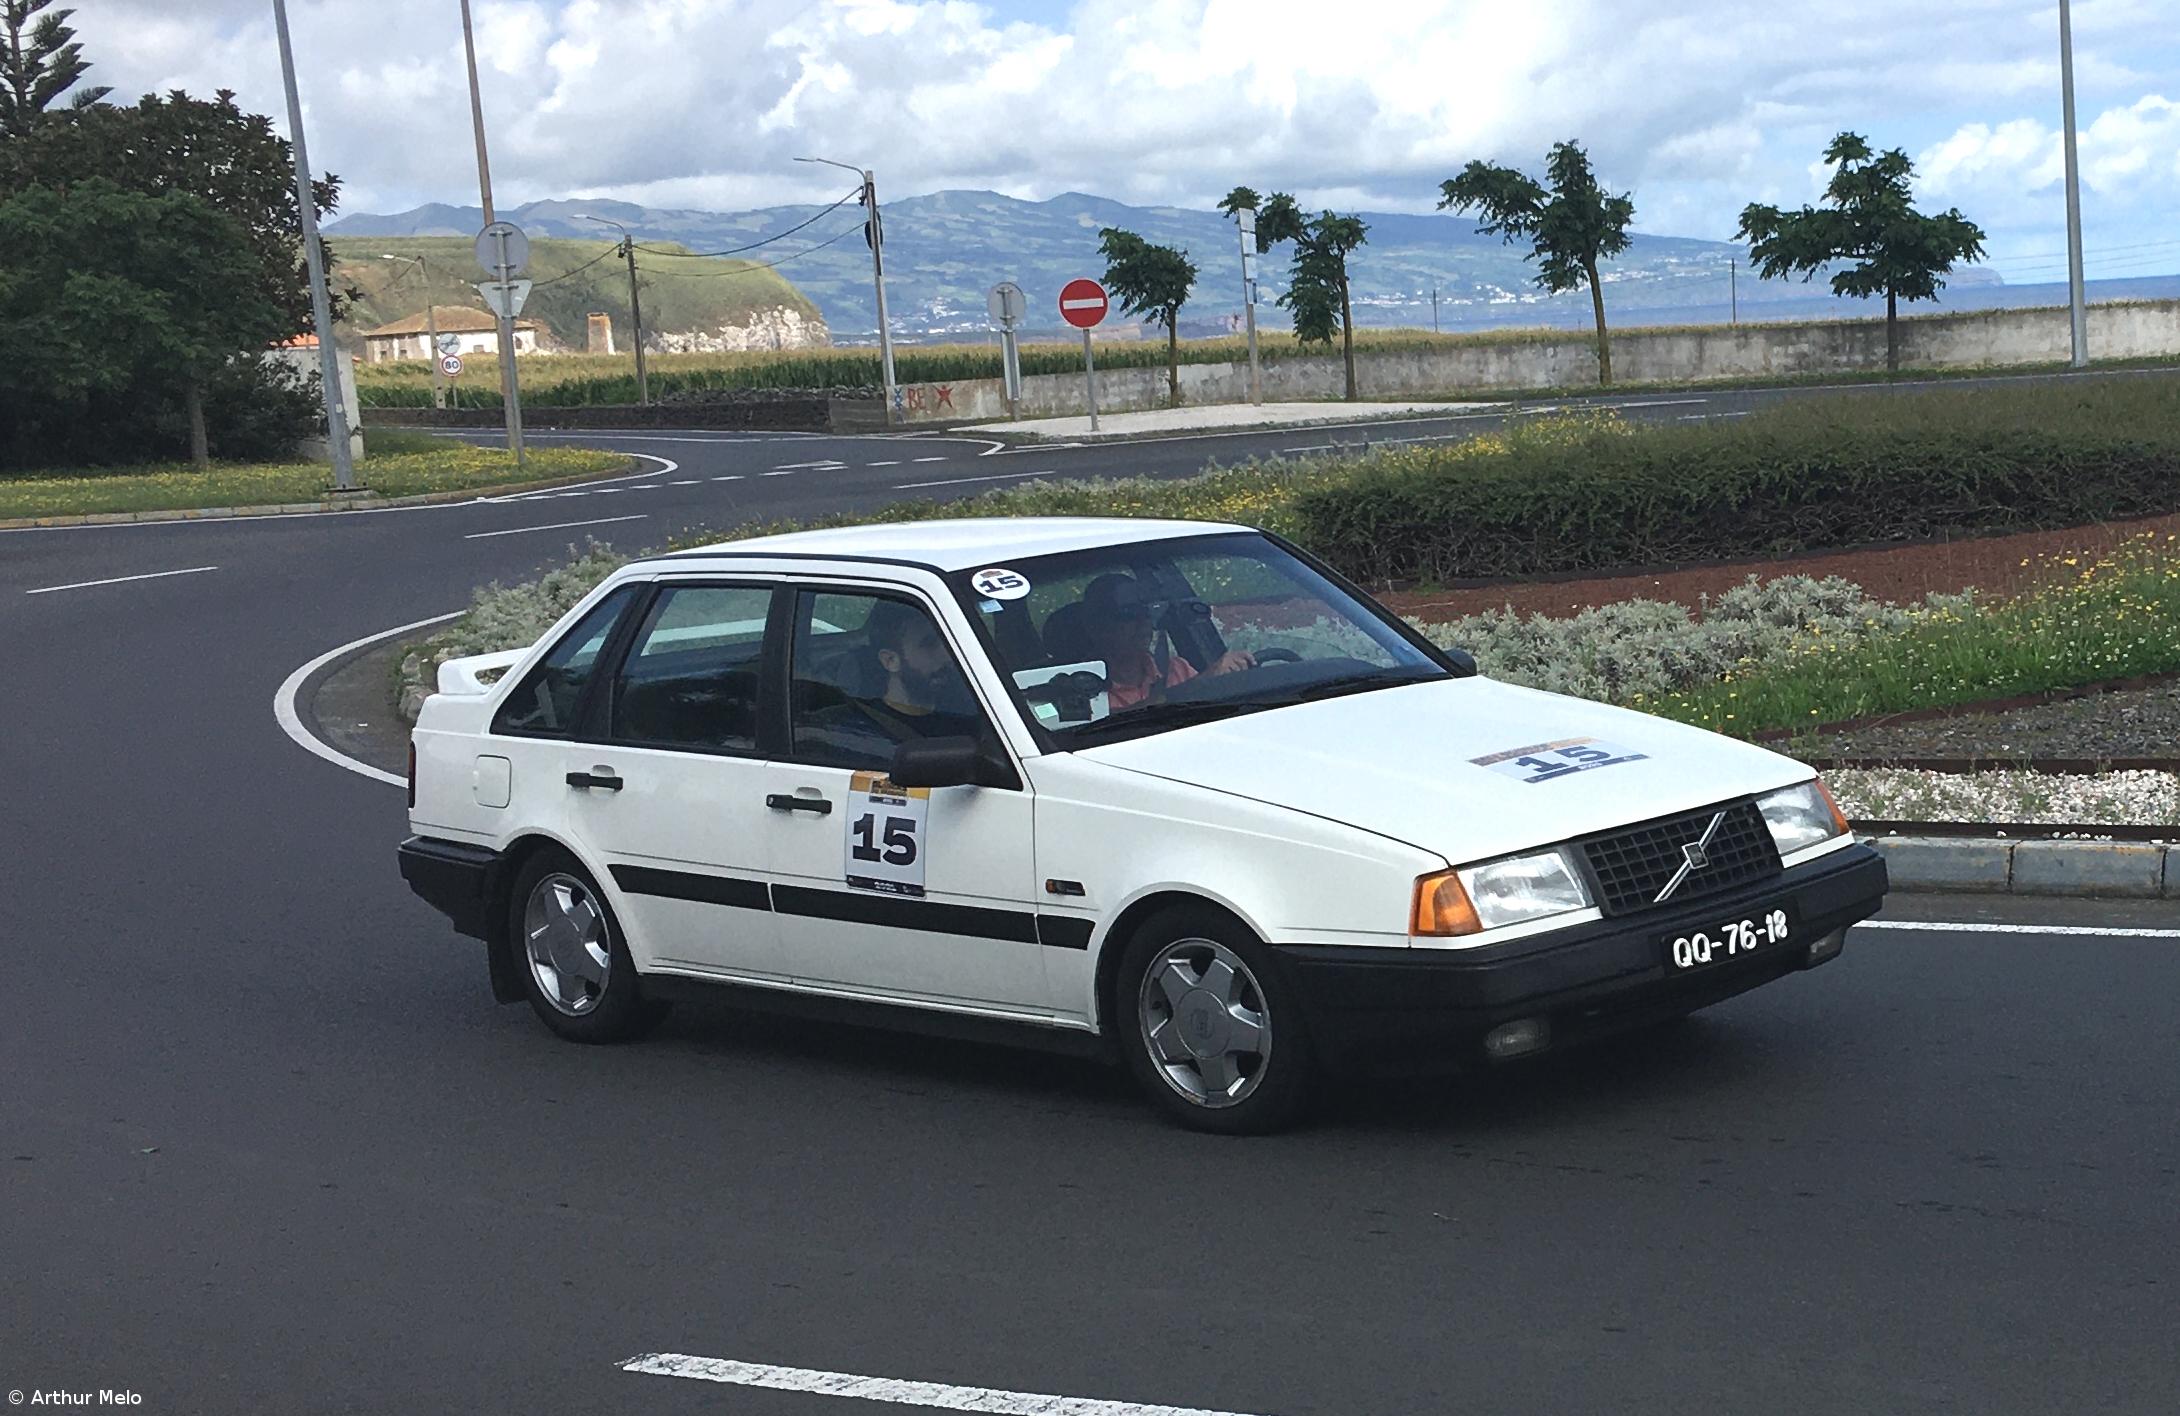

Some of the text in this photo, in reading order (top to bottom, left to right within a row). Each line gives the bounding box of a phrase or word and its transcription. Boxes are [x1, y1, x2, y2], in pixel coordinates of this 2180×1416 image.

[445, 360, 459, 370] 80
[979, 575, 1023, 593] 15
[1515, 746, 1611, 773] 15
[853, 813, 917, 866] 15
[1673, 909, 1788, 968] QQ-76-18
